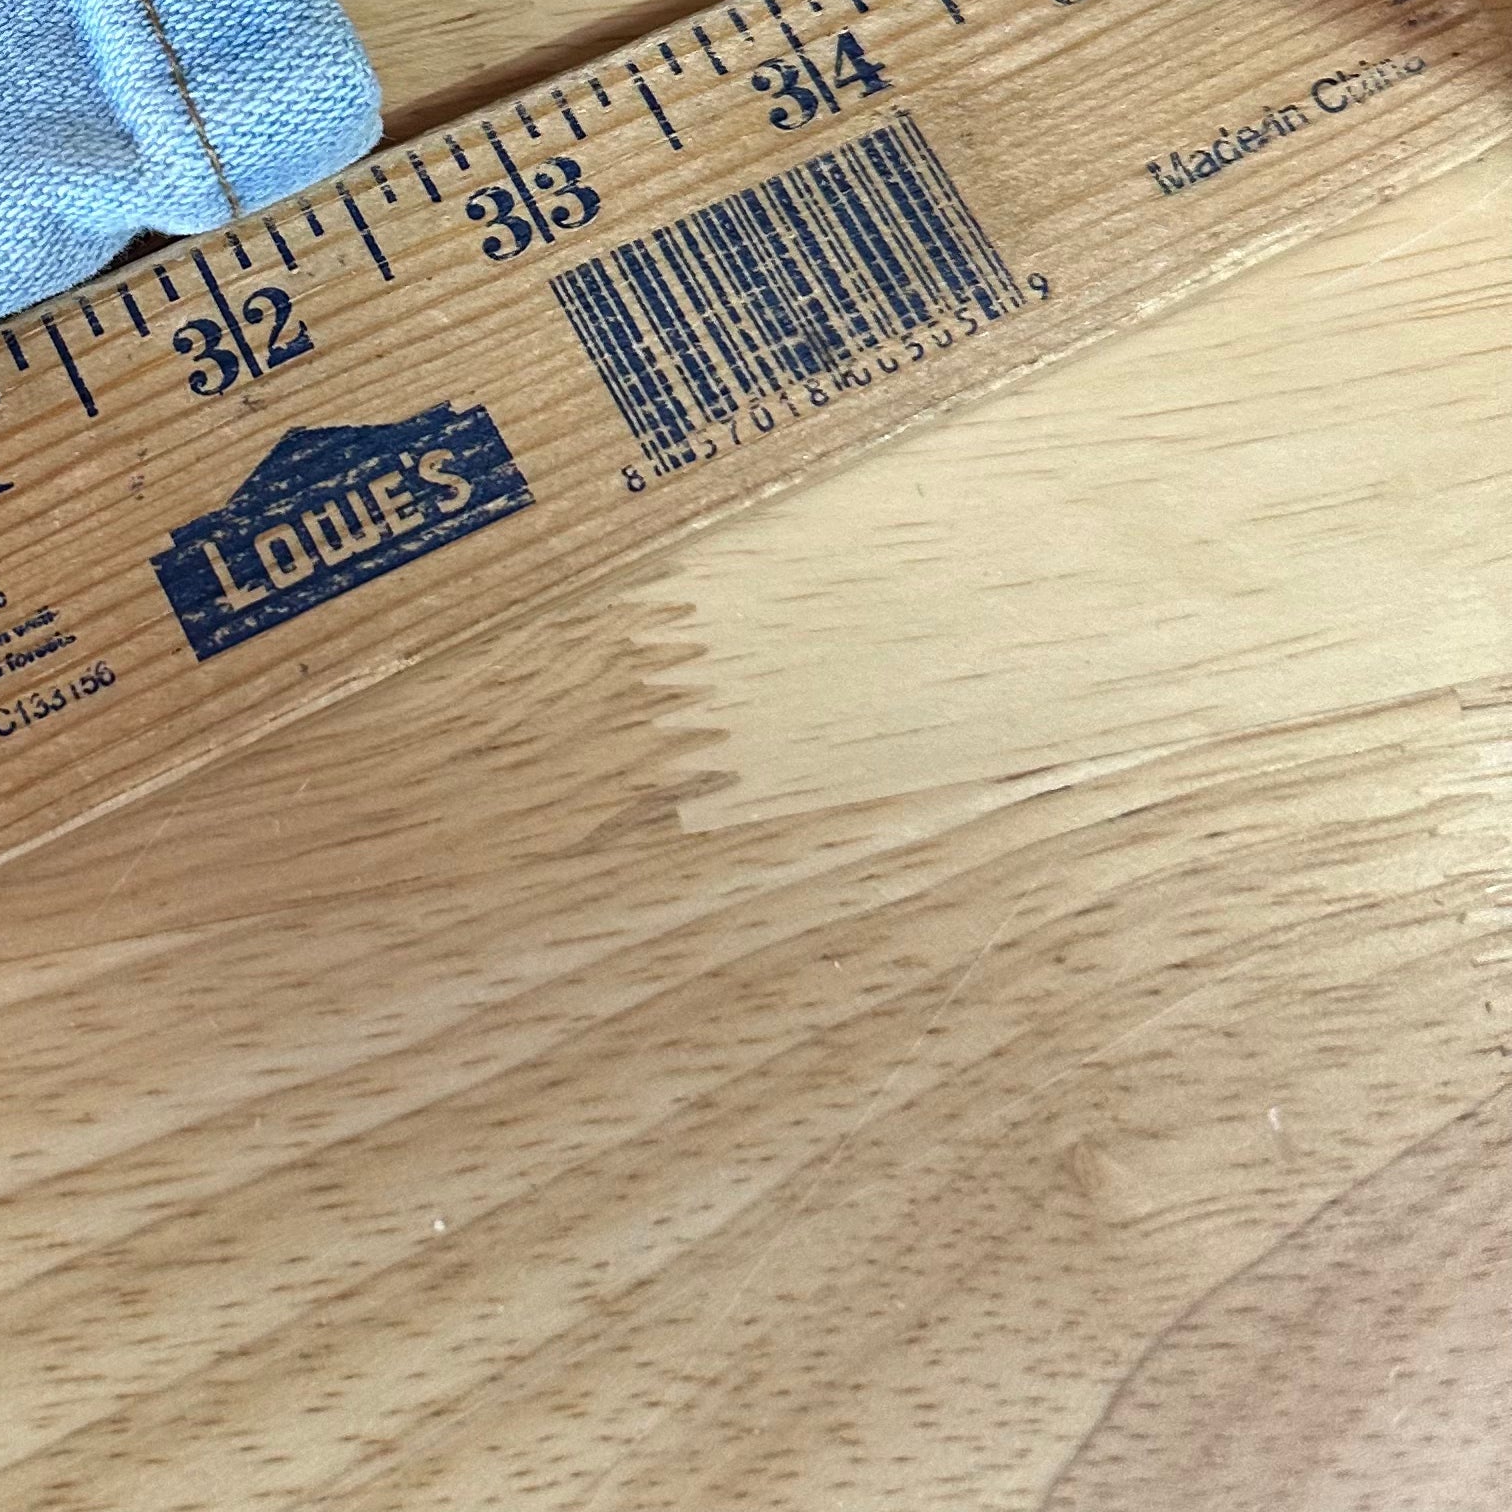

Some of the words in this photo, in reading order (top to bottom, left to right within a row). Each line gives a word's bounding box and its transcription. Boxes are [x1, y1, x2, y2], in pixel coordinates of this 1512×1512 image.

[751, 28, 895, 130] 34
[1147, 127, 1269, 195] Made
[1264, 102, 1311, 136] in
[465, 157, 601, 261] 33
[173, 287, 314, 396] 32
[203, 448, 473, 615] LOWE'S
